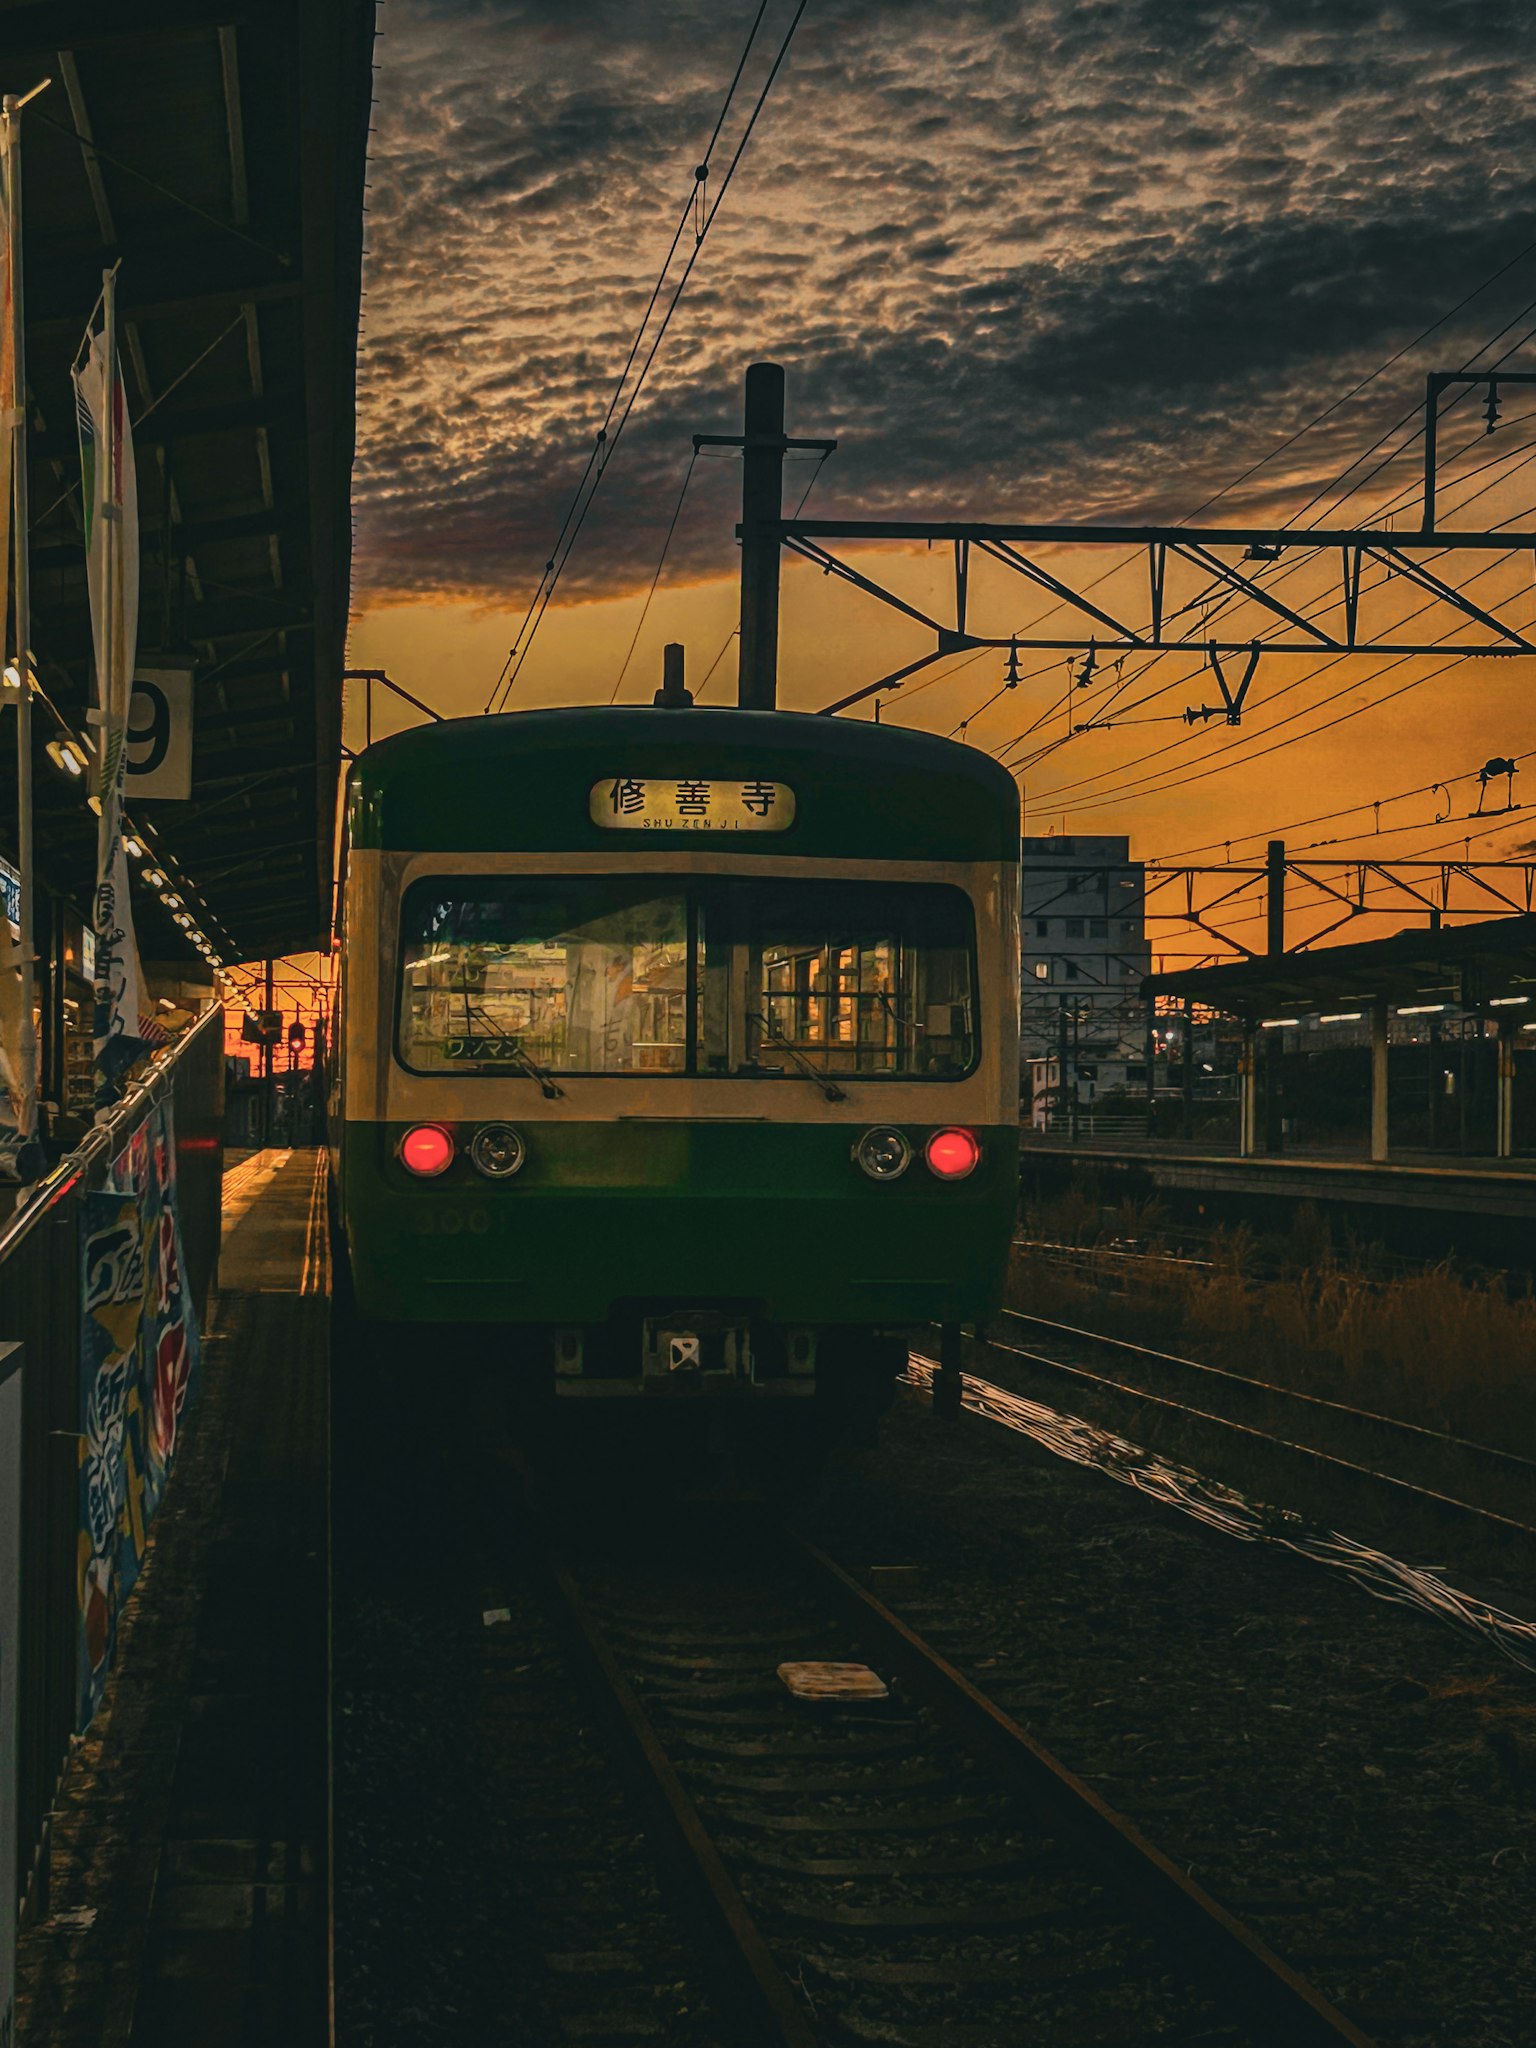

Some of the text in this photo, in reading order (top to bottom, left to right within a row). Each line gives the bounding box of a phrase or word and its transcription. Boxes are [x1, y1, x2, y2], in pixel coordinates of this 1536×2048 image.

[127, 680, 170, 774] 9
[610, 779, 775, 816] 修善寺
[643, 818, 673, 828] SHU
[448, 1038, 519, 1057] ワンマン
